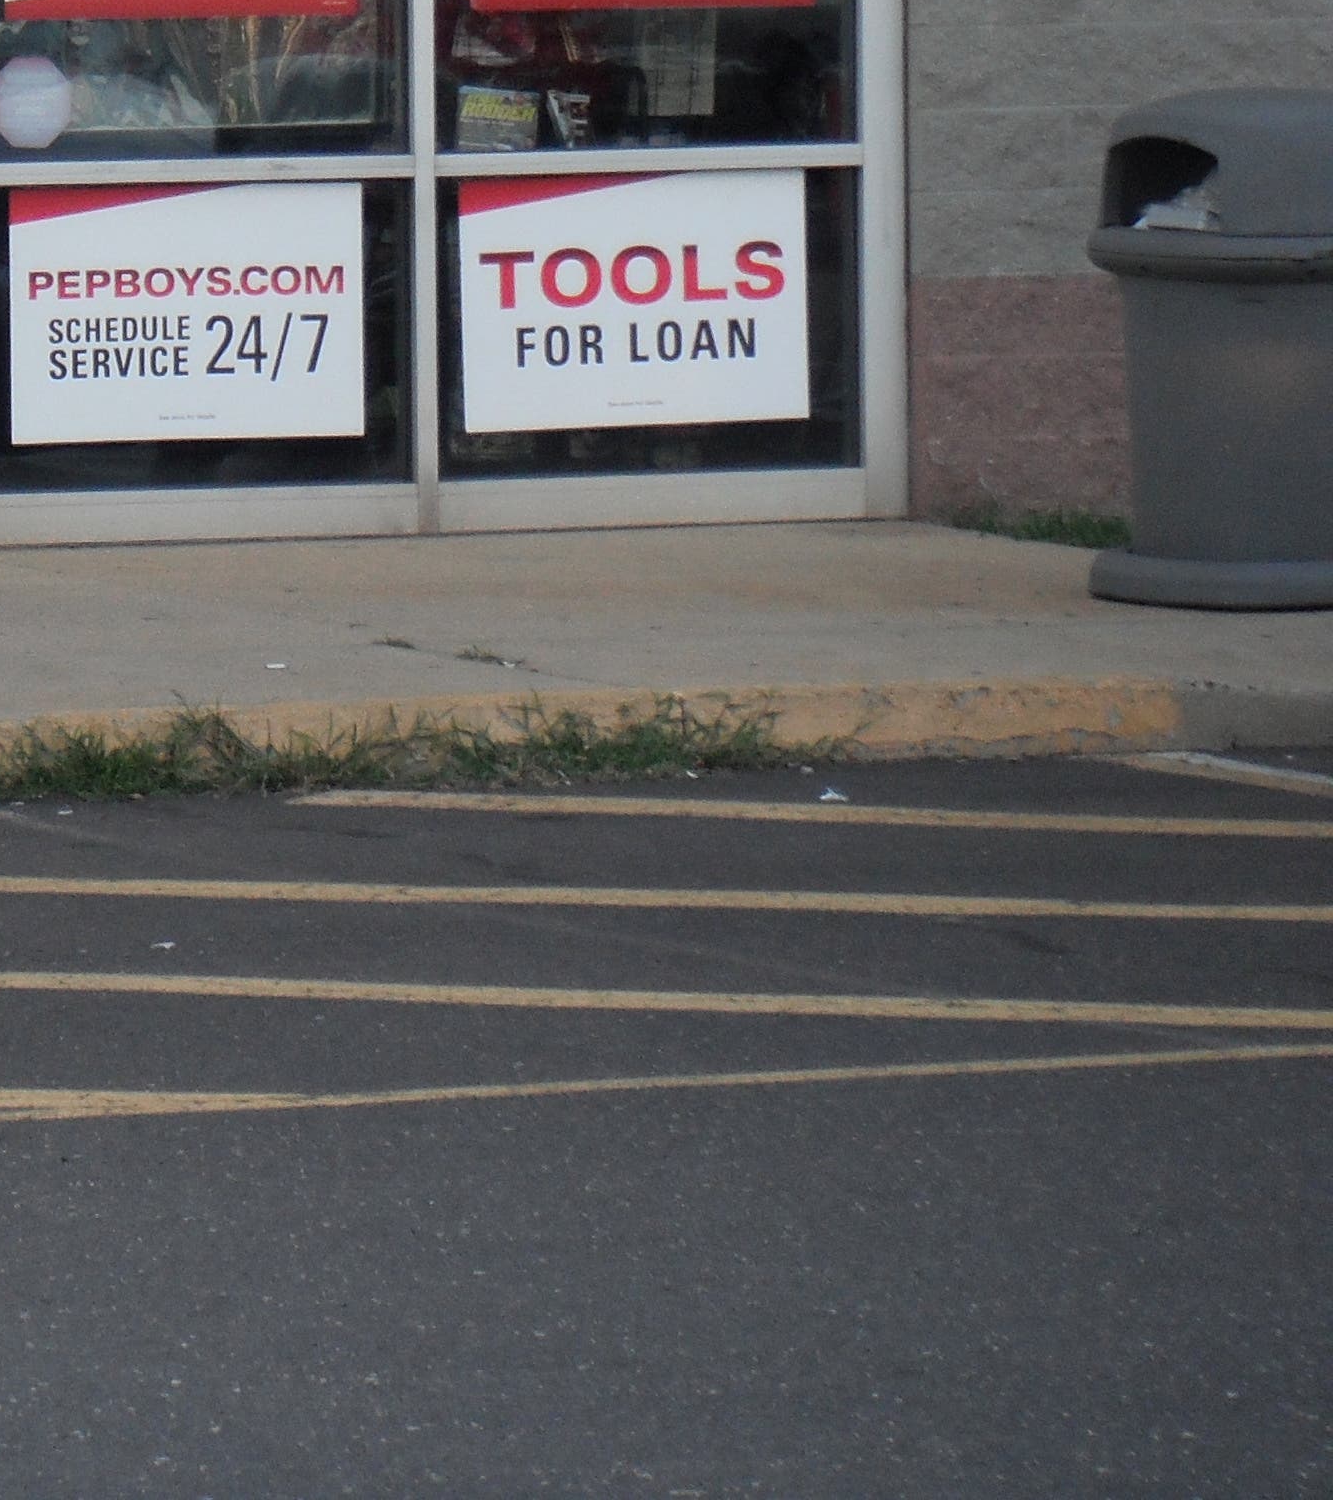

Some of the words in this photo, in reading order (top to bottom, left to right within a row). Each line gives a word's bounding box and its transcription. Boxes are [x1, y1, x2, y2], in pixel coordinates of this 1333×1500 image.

[28, 264, 346, 303] PEPBOYS.COM
[479, 240, 786, 312] TOOLS
[47, 313, 192, 346] SCHEDULE
[205, 312, 331, 383] 24/7
[47, 346, 190, 382] SERVICE
[515, 322, 605, 369] FOR
[628, 315, 759, 366] LOAN
